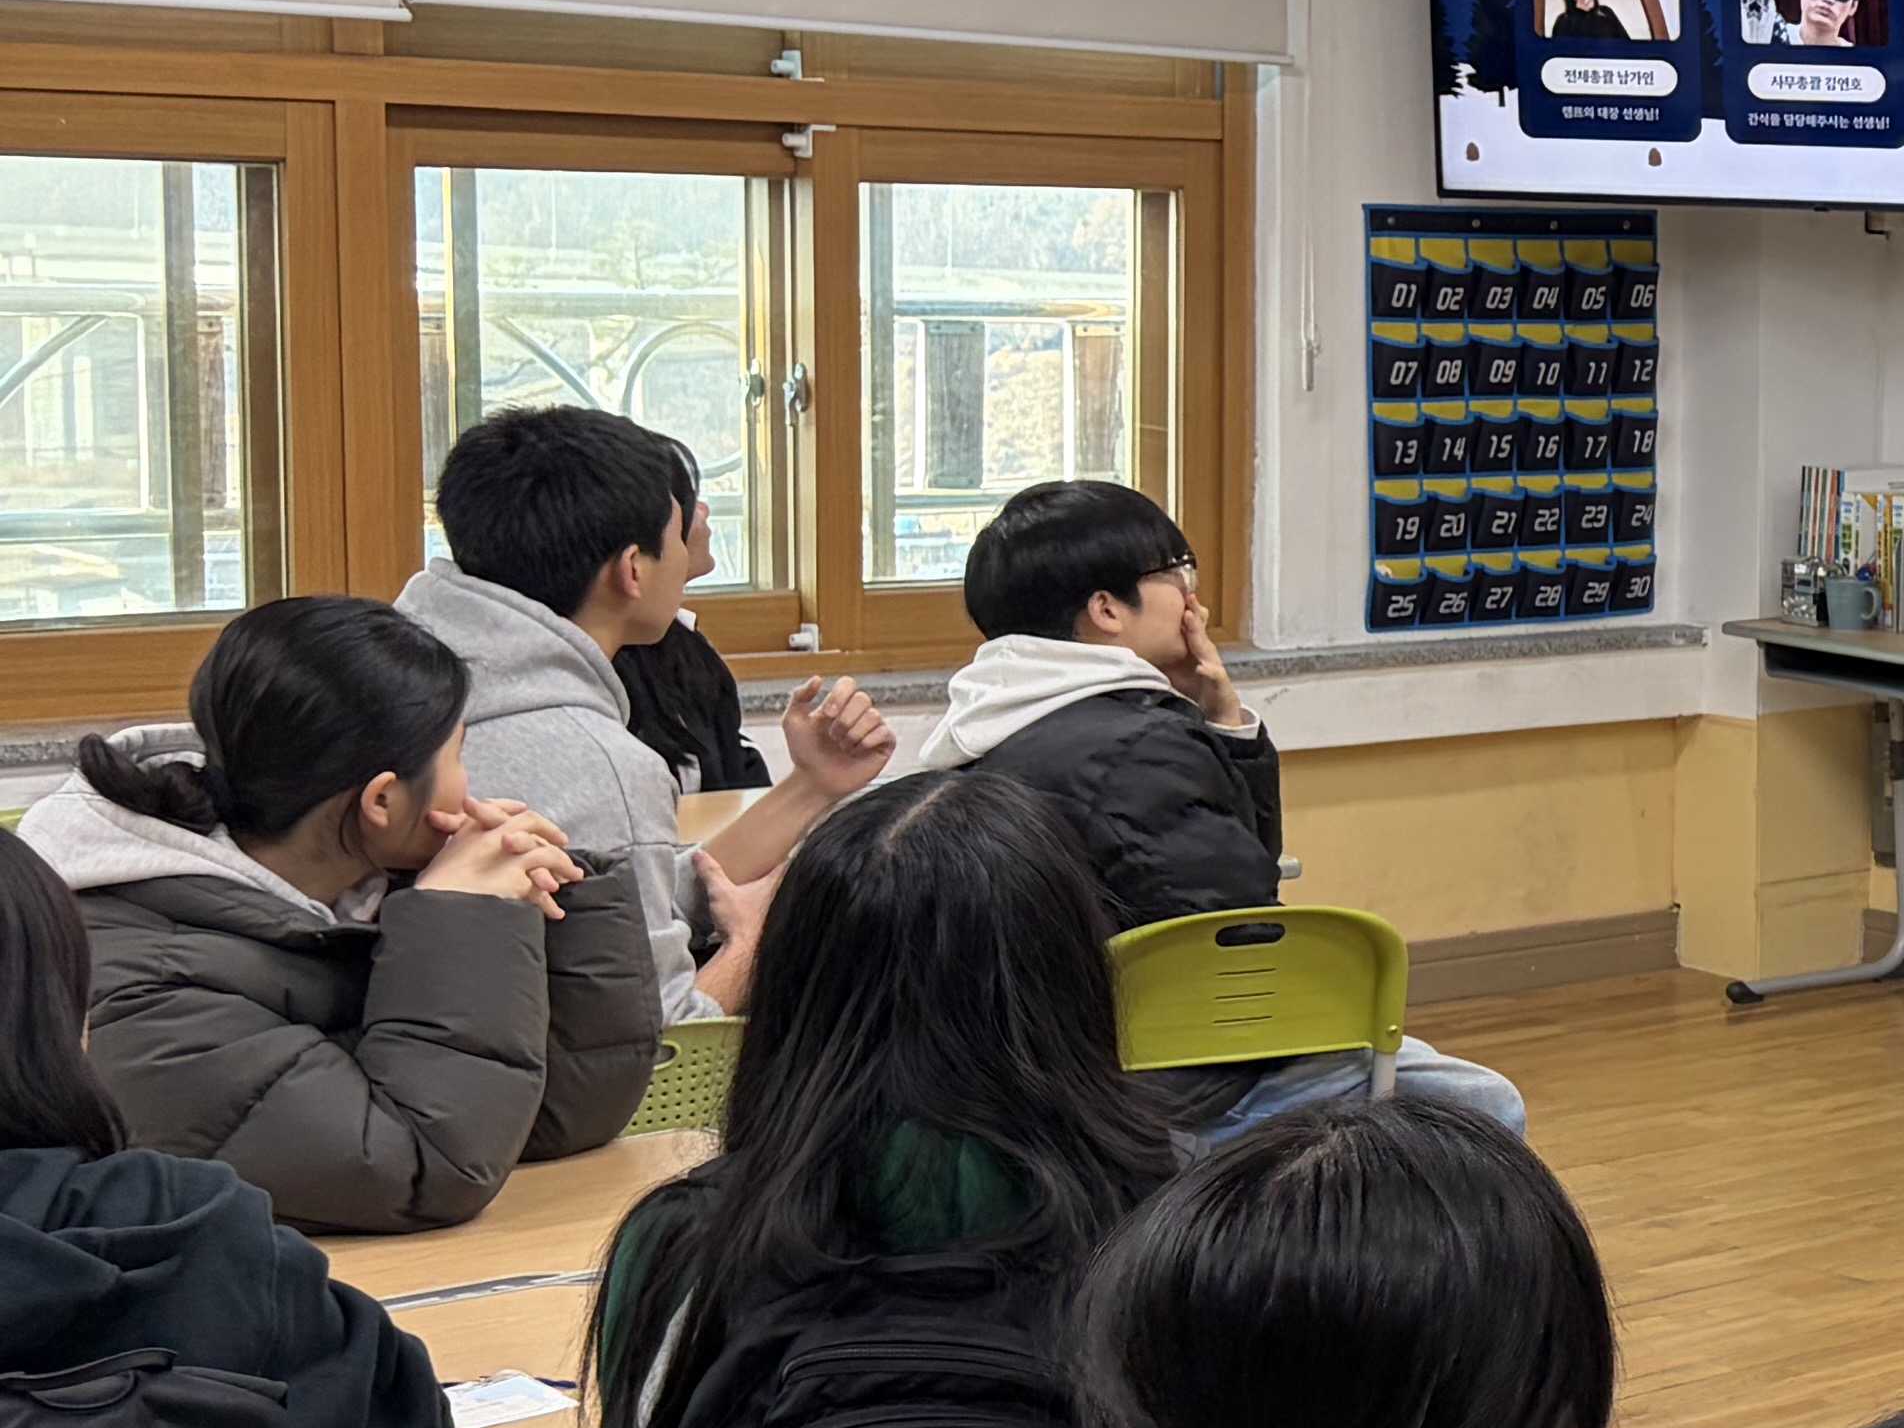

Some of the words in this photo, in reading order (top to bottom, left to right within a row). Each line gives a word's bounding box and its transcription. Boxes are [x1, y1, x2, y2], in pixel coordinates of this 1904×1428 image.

[1392, 283, 1417, 307] 01
[1437, 287, 1464, 310] 02
[1485, 286, 1512, 309] 03
[1533, 287, 1558, 309] 04
[1582, 286, 1605, 309] 05
[1630, 283, 1655, 308] 06
[1390, 361, 1417, 384] 07
[1436, 359, 1462, 384] 08
[1489, 359, 1516, 382] 09
[1537, 362, 1560, 384] 10
[1587, 362, 1607, 384] 11
[1631, 359, 1653, 382] 12
[1394, 439, 1418, 464] 13
[1442, 437, 1466, 461] 14
[1489, 434, 1512, 458] 15
[1536, 435, 1559, 458] 16
[1584, 435, 1607, 458] 17
[1632, 430, 1654, 453] 18
[1440, 513, 1465, 537] 20
[1491, 511, 1516, 533] 21
[1534, 508, 1560, 531] 22
[1581, 505, 1607, 528] 23
[1630, 504, 1653, 526] 24
[1395, 516, 1419, 539] 19
[1485, 586, 1512, 609] 27
[1535, 585, 1561, 606] 28
[1583, 581, 1609, 602] 29
[1626, 576, 1650, 598] 30
[1387, 594, 1416, 617] 25
[1439, 592, 1467, 614] 26
